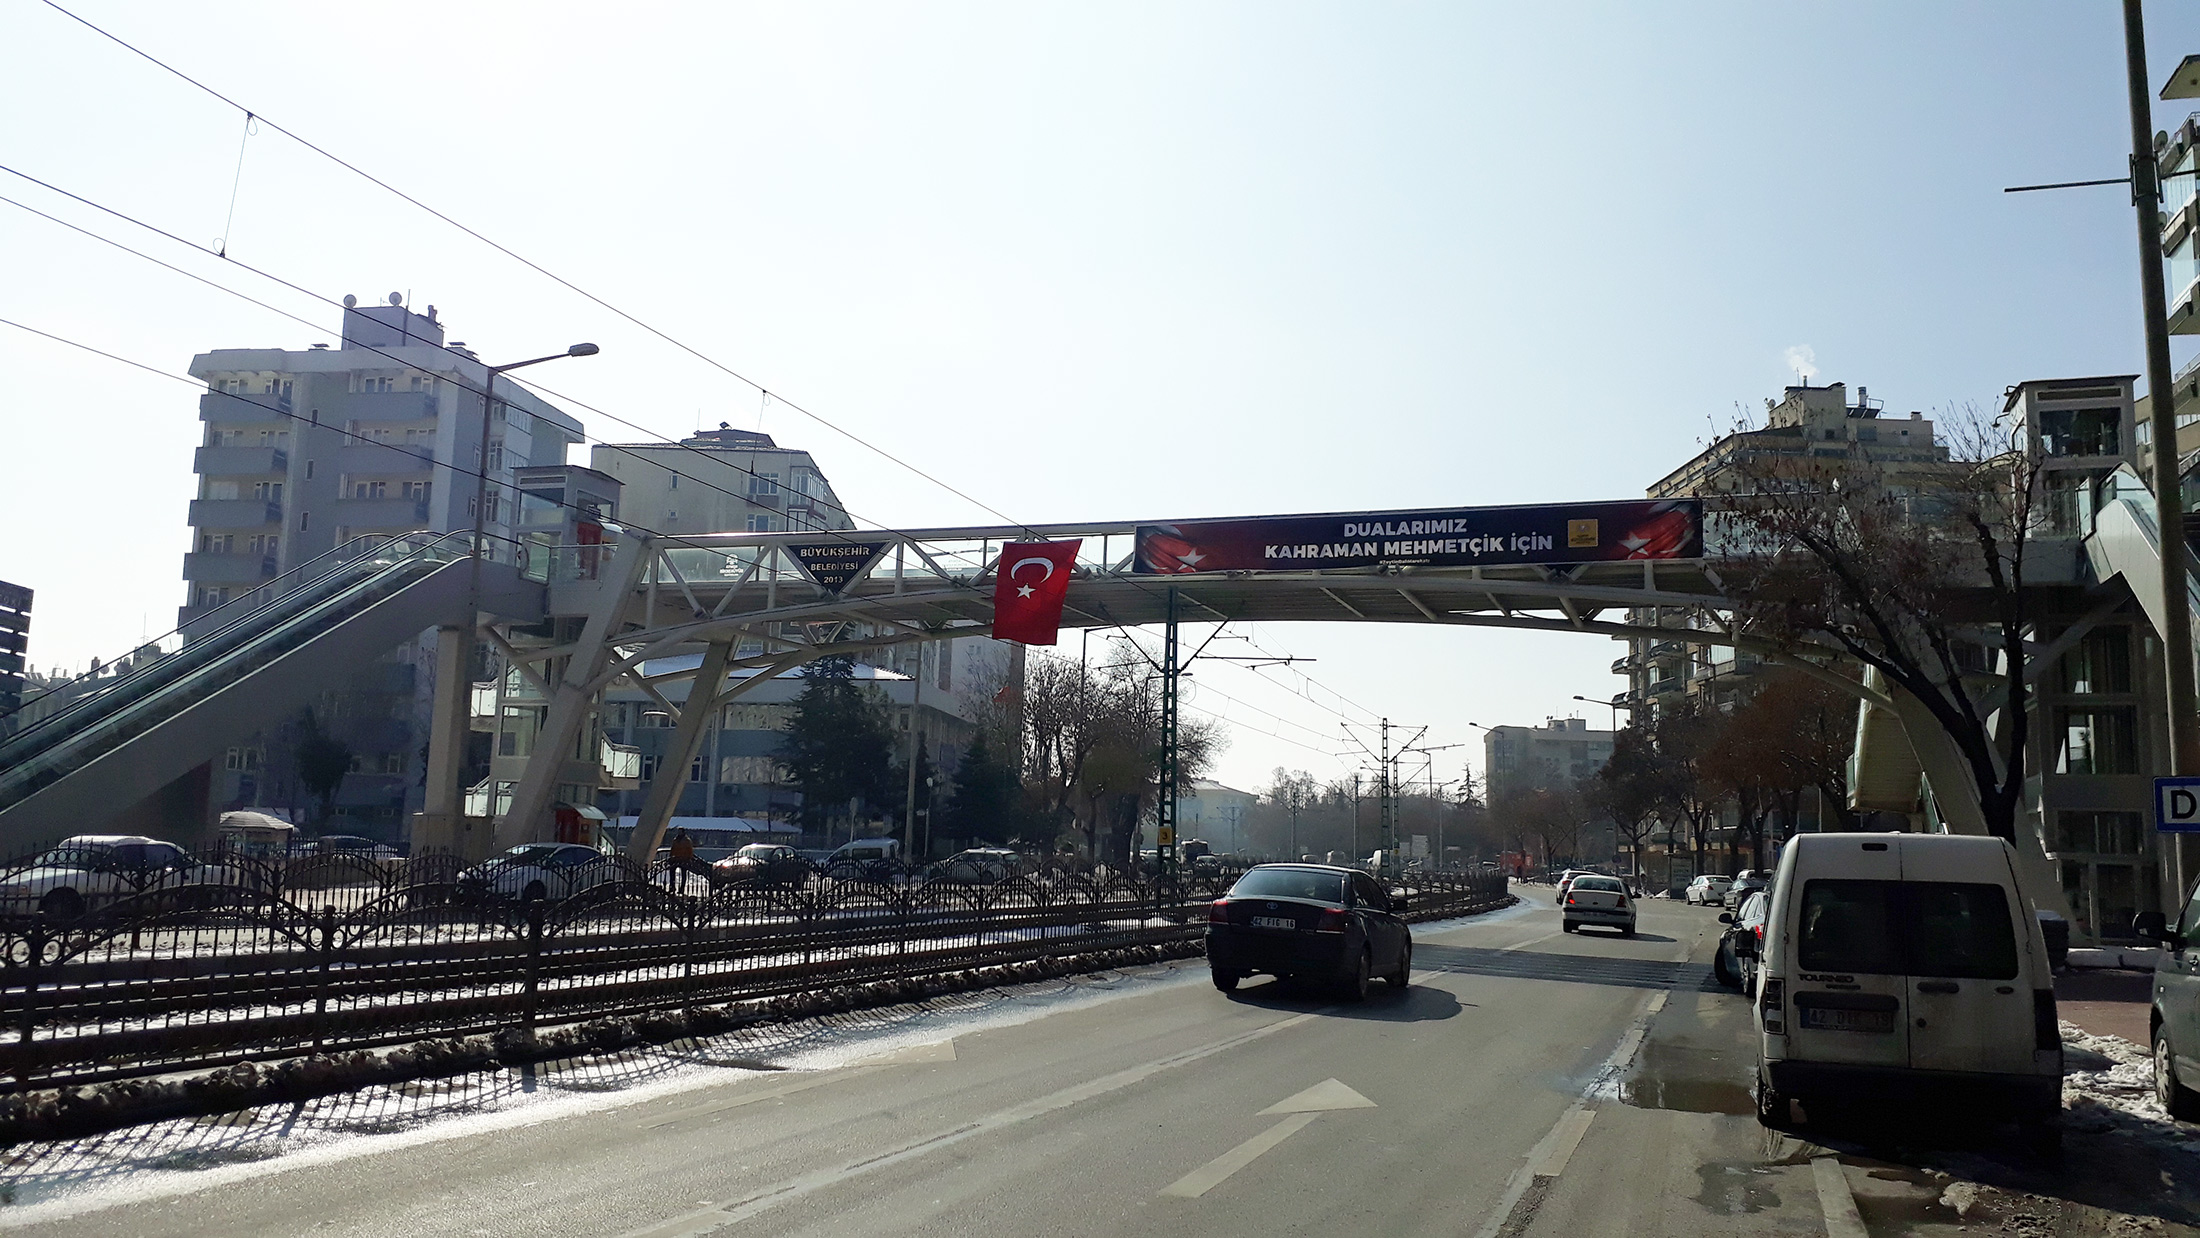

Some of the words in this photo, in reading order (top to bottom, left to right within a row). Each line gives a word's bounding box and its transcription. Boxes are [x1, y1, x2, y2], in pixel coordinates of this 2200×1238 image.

[1343, 518, 1467, 537] DUALARIMIZ
[1264, 542, 1378, 559] KAHRAMAN
[1384, 533, 1504, 557] MEHMETÇİK
[1510, 531, 1553, 555] İÇİN
[800, 545, 870, 558] BÜYÜKŞEHİR
[810, 561, 859, 571] BELEDİYESİ
[823, 576, 844, 584] 2013
[2170, 789, 2197, 820] D
[1162, 831, 1168, 840] 3
[1798, 973, 1855, 983] TOURNEO
